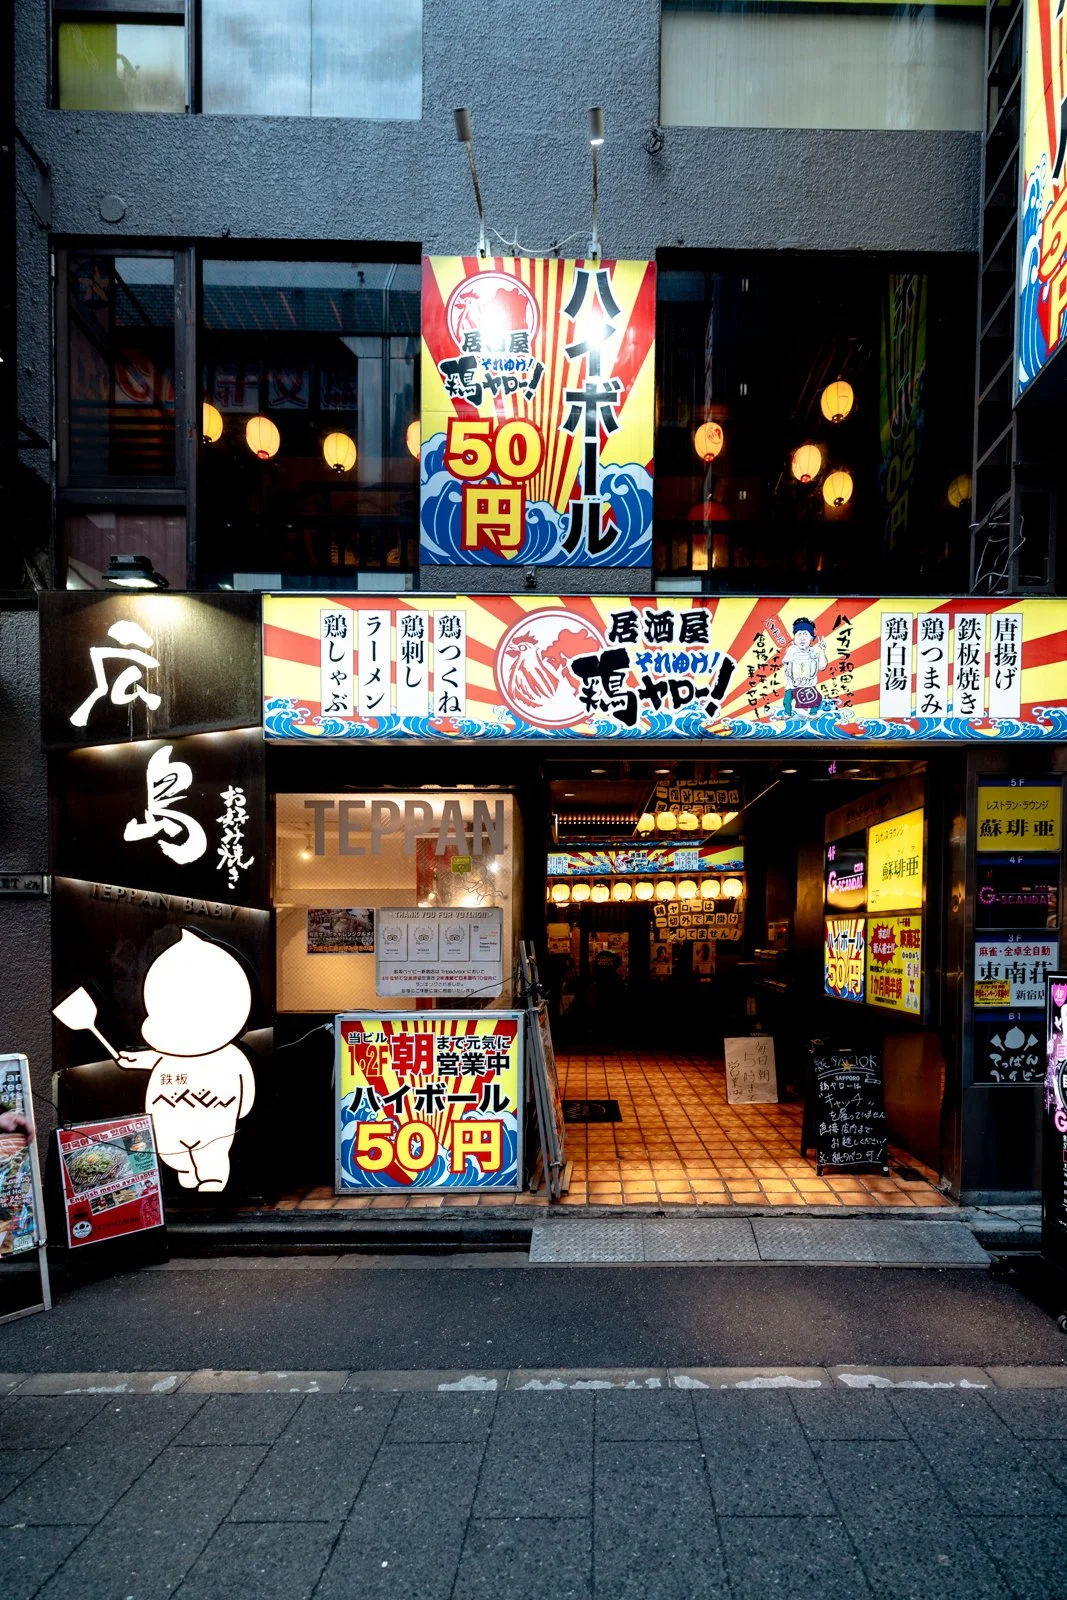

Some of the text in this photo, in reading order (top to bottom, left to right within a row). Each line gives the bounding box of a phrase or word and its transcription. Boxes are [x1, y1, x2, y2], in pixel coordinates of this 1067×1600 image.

[562, 269, 622, 556] ハイボール
[608, 610, 710, 644] 居酒屋
[324, 614, 348, 712] 鶏しゃぶ
[363, 616, 385, 710] ラーメン
[401, 615, 424, 688] 鶏刺し
[437, 615, 462, 714] 鶏つくね
[636, 652, 721, 674] それゆけ!
[885, 617, 908, 691] 鶏白湯
[921, 617, 944, 714] 鶏つまみ
[957, 617, 981, 714] 鉄板焼き
[994, 617, 1018, 691] 唐揚げ
[986, 800, 1049, 810] レストラン・ラウンジ
[216, 785, 255, 890] お好み焼き
[304, 800, 504, 855] TEPPAN
[91, 885, 172, 910] TEPPAN
[395, 911, 419, 919] THANK
[422, 911, 436, 919] YOU
[439, 911, 453, 919] FOR
[656, 914, 738, 927] 一切外で声掛け
[678, 929, 740, 941] してません!
[978, 961, 1052, 984] 東南荘
[348, 1032, 387, 1044] 当ビル
[436, 1036, 511, 1049] まで元気に
[391, 1033, 434, 1076] 朝
[436, 1052, 510, 1076] 営業中
[989, 1053, 1038, 1068] てっぱん
[160, 1073, 188, 1085] 鉄板
[348, 1083, 511, 1114] ハイボール
[70, 1172, 155, 1203] English menu available
